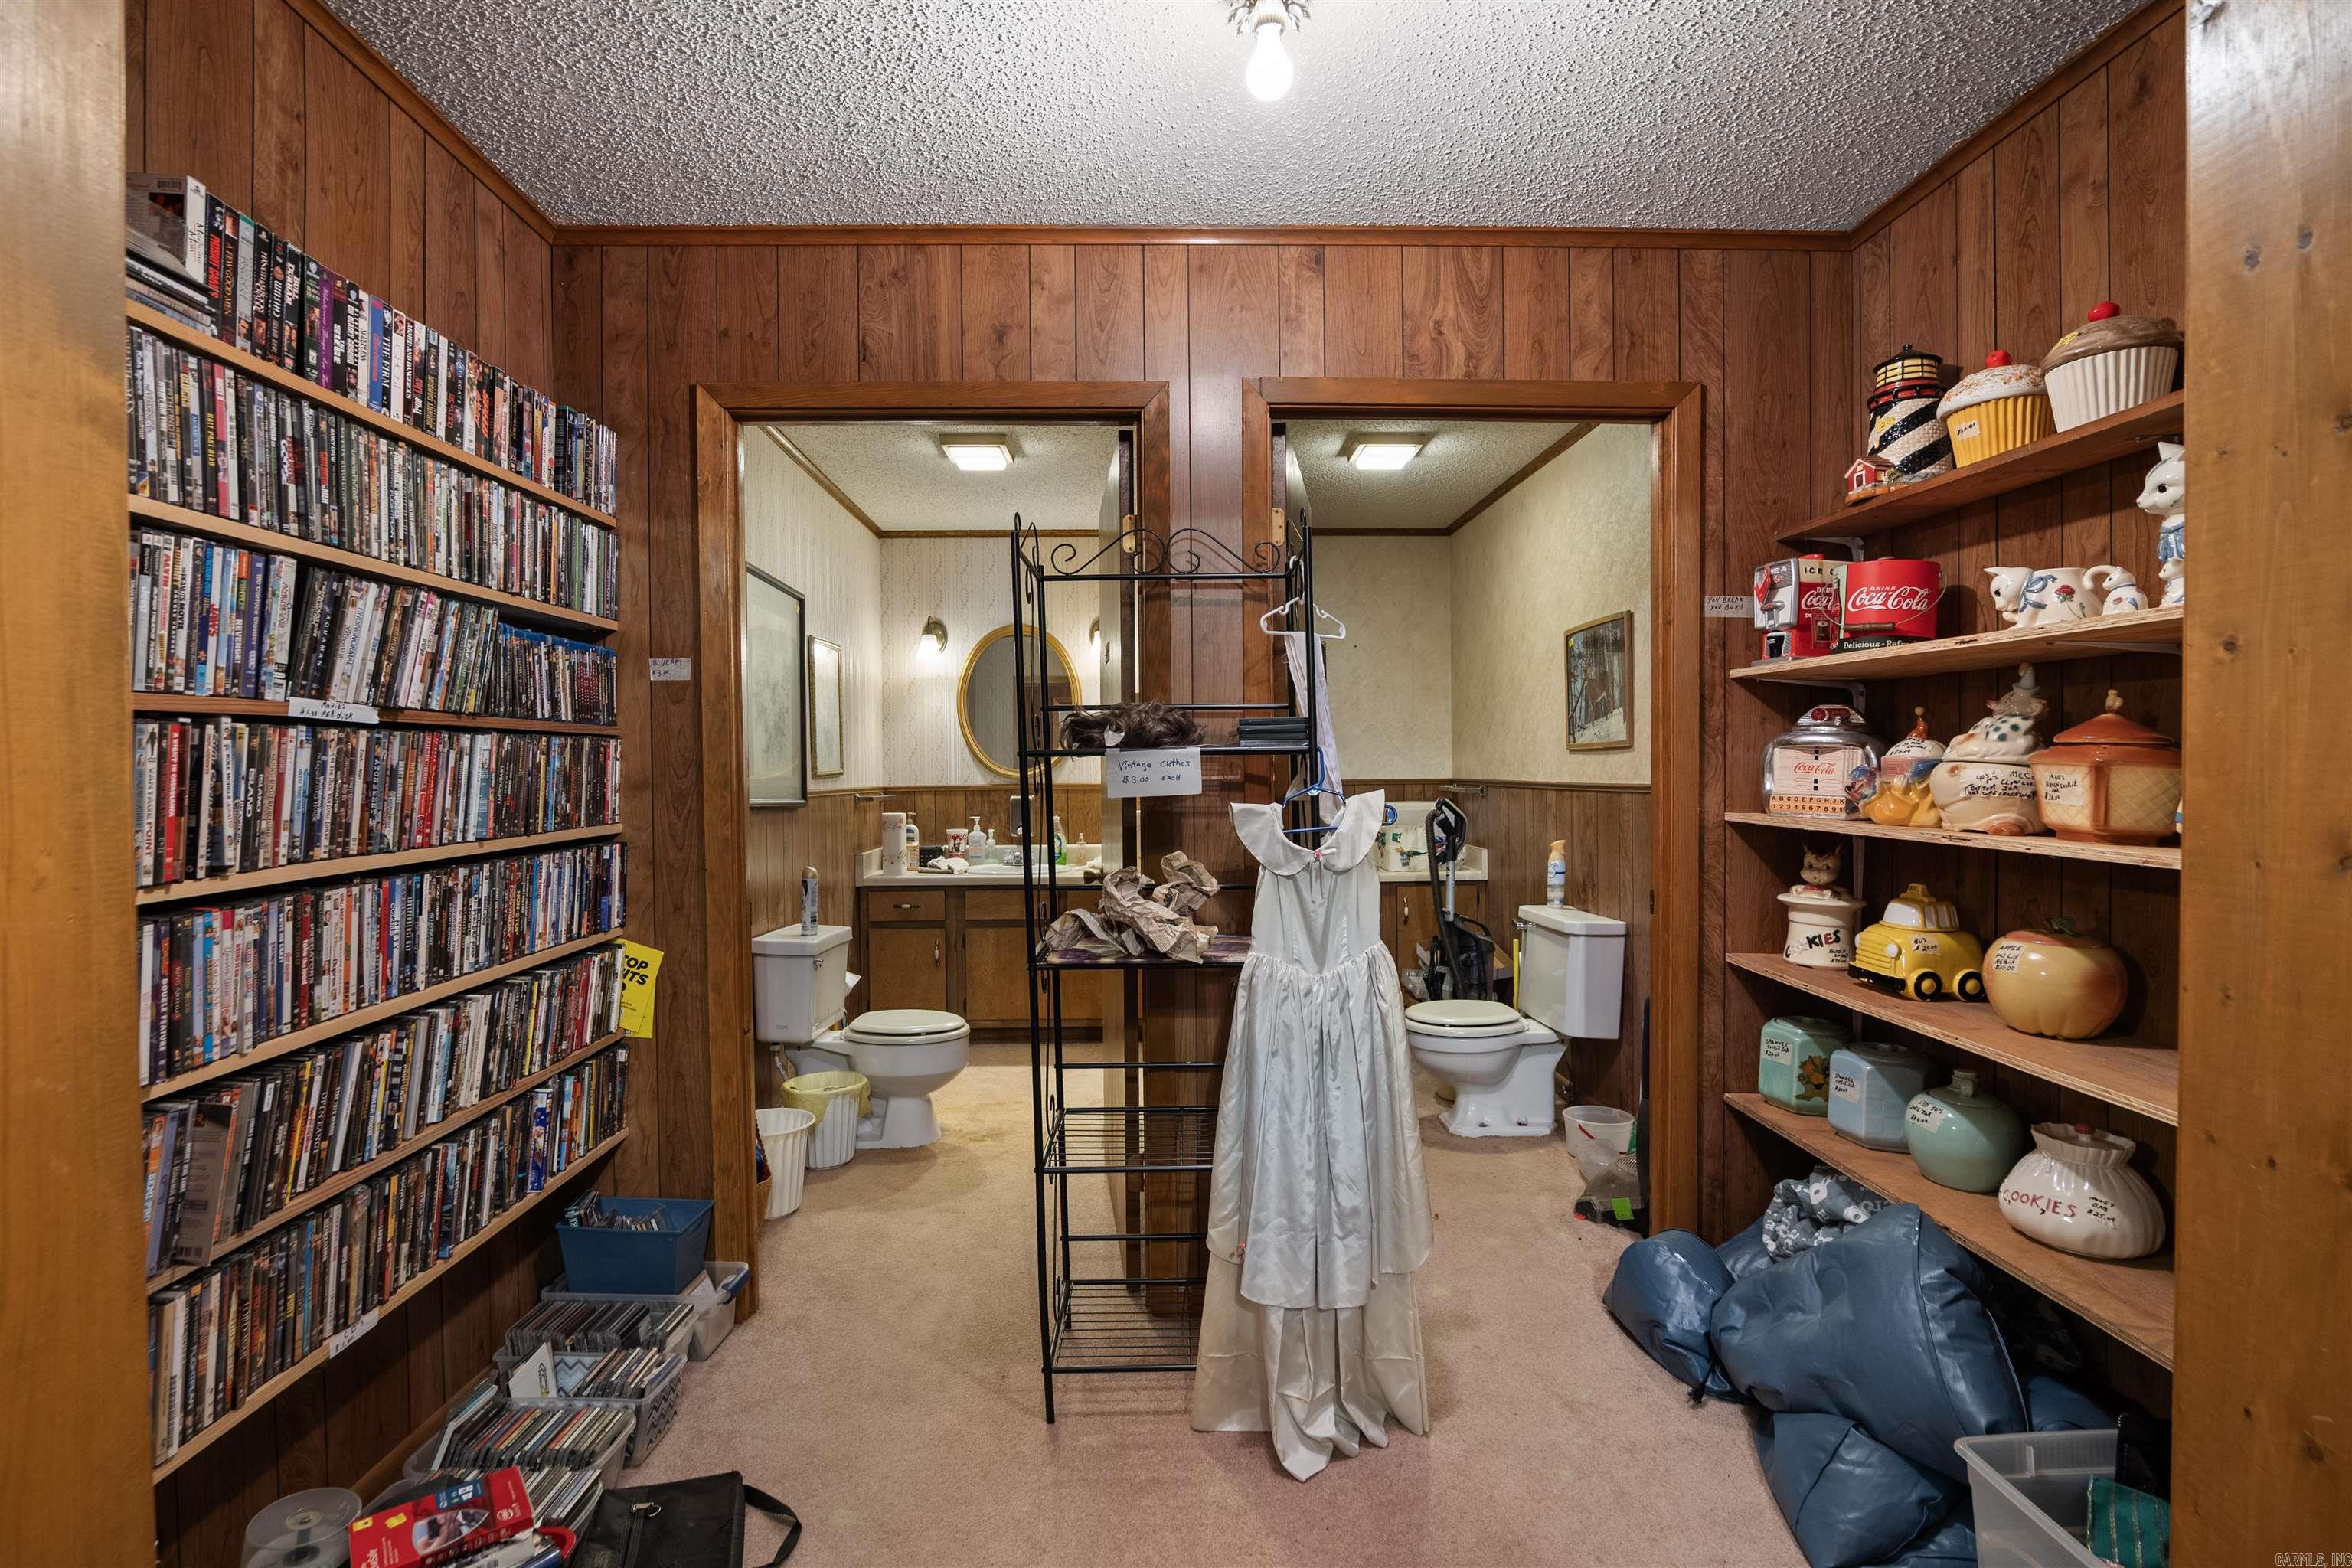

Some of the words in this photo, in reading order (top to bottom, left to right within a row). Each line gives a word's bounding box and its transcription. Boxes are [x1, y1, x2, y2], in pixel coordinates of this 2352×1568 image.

[209, 234, 220, 266] PATRIOT
[273, 280, 282, 317] CHISUM
[286, 263, 294, 305] DURHAM
[292, 277, 301, 299] BULL
[320, 489, 328, 504] MEN
[162, 554, 171, 587] ALVIN
[139, 586, 149, 612] Jeep
[253, 586, 262, 615] Cartoon
[177, 603, 185, 630] MOVIE
[208, 604, 219, 637] JAWS
[251, 616, 260, 645] Classics
[234, 619, 243, 664] REVENGE!
[317, 615, 331, 666] AQUAMAN
[1844, 642, 1880, 650] Delicious
[268, 753, 276, 778] GOING
[1119, 760, 1152, 772] Vintage
[1160, 757, 1191, 768] Clothes
[145, 768, 155, 821] VANTAGE
[246, 768, 255, 817] ISLAND
[266, 780, 276, 838] UNDERGROUND
[145, 822, 154, 858] POINT
[318, 1092, 328, 1122] OPEN
[369, 1089, 378, 1114] BOILER
[312, 1123, 323, 1153] RANGE
[367, 1115, 376, 1136] ROOM
[2003, 1190, 2077, 1218] COOKIES
[286, 1292, 295, 1318] FURY
